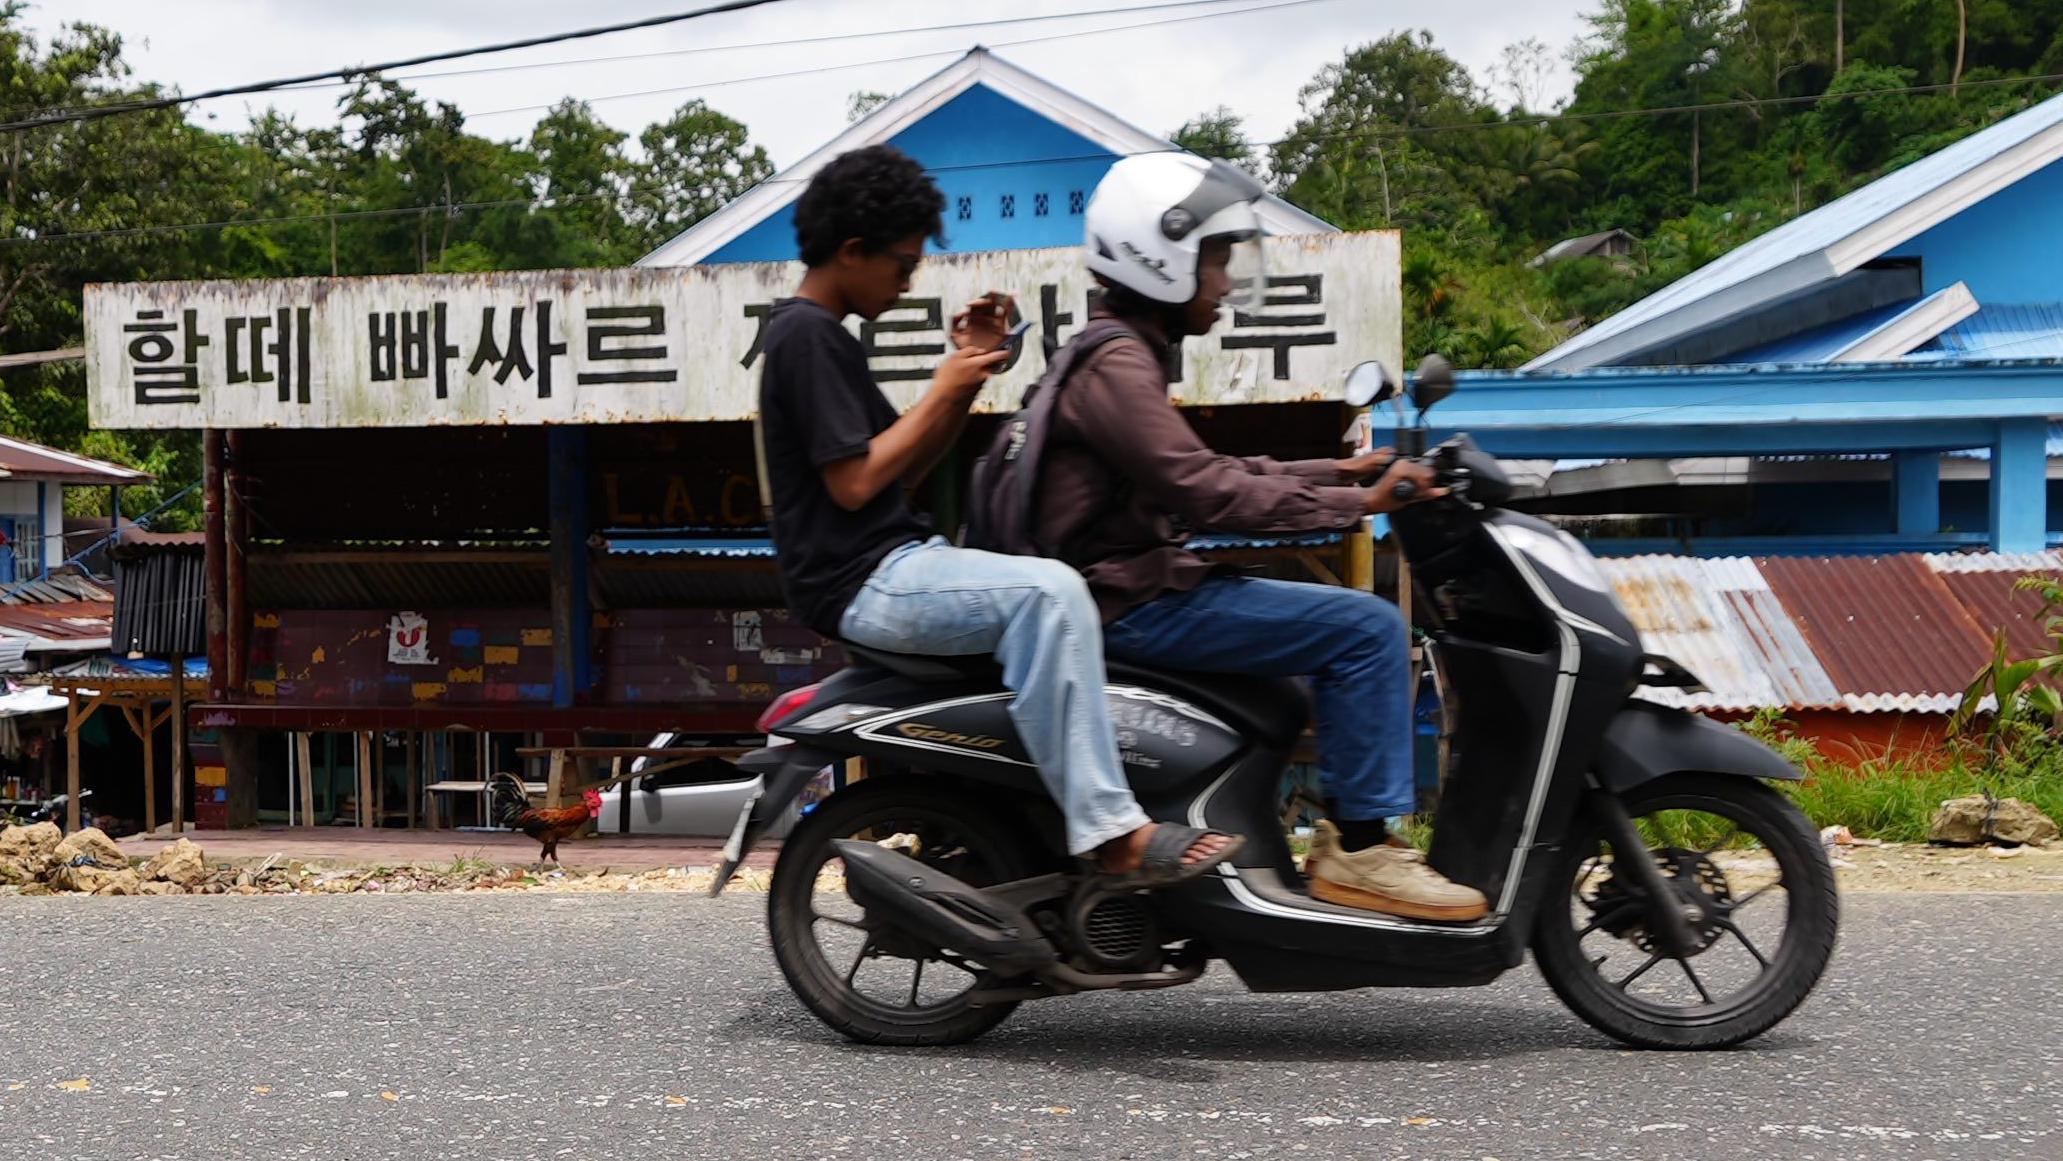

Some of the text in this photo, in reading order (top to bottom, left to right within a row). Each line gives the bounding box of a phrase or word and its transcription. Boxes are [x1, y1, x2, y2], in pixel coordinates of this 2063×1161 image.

[121, 306, 312, 405] 할떼
[368, 300, 678, 400] 빠싸르
[896, 722, 1006, 748] Genio
